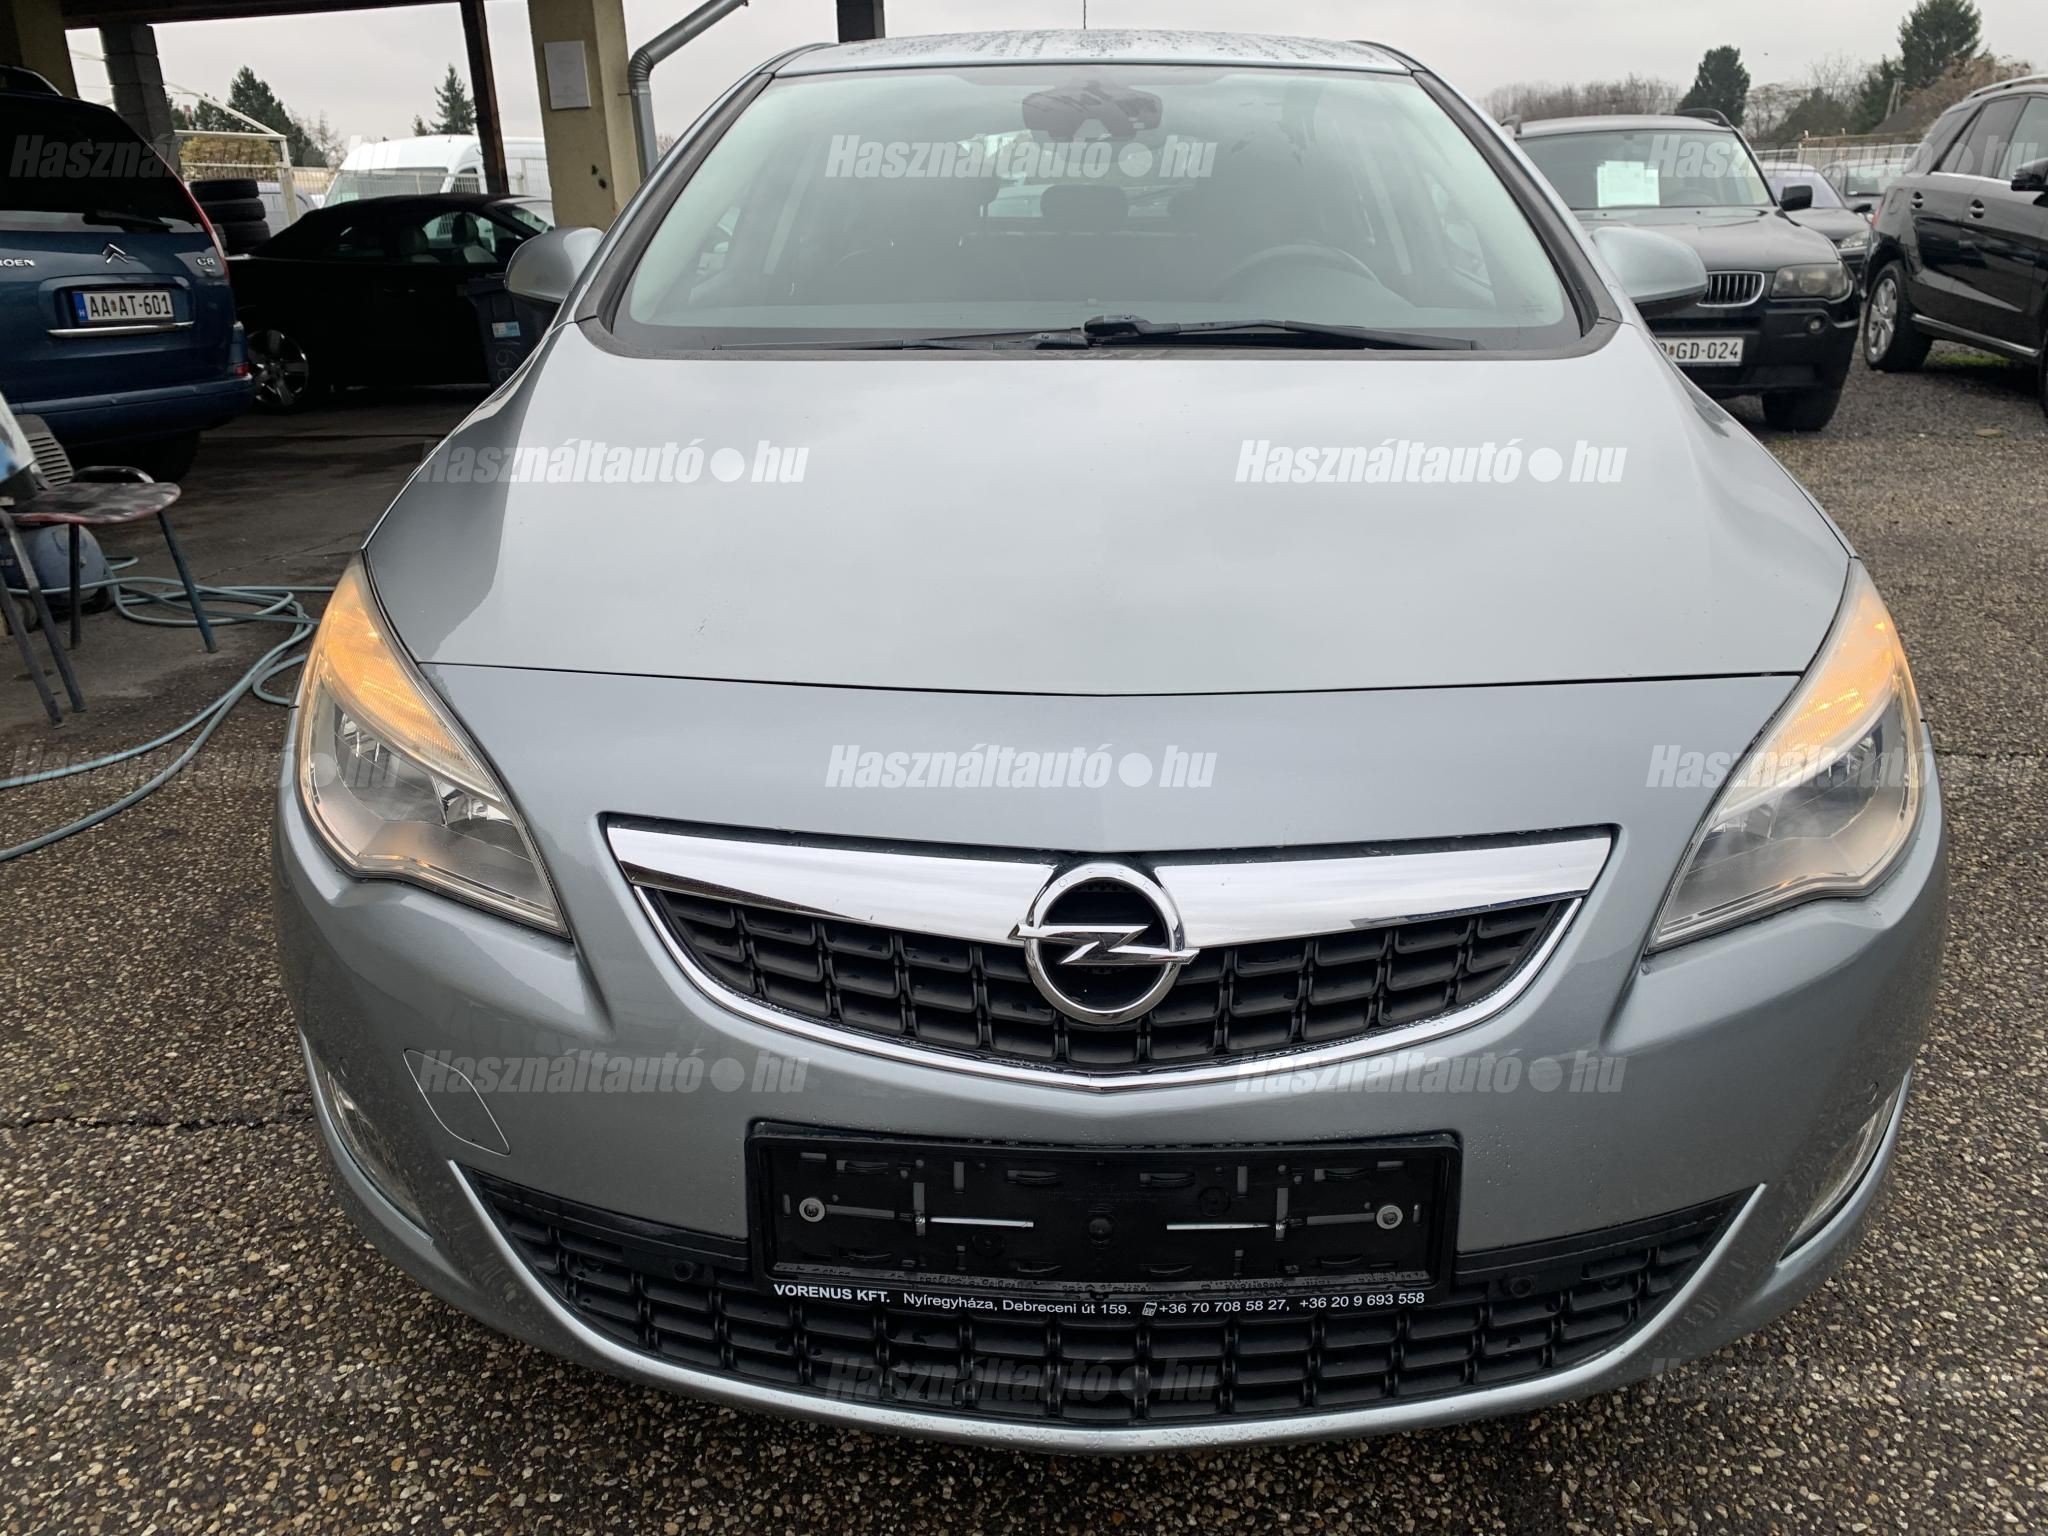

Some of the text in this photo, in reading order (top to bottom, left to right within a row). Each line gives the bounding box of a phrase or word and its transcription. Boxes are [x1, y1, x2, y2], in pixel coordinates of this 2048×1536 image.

[774, 1284, 852, 1300] VORENUS
[857, 1289, 890, 1303] KFT.
[903, 1293, 998, 1311] Nyíregyháza,
[1003, 1300, 1077, 1315] Debreceni
[1081, 1300, 1095, 1315] út
[1100, 1304, 1131, 1315] 159.
[1192, 1302, 1210, 1314] 70
[1214, 1301, 1241, 1313] 708
[1245, 1300, 1264, 1312] 58
[1268, 1299, 1290, 1312] 27,
[1300, 1298, 1327, 1309] +36
[1331, 1296, 1349, 1308] 20
[1353, 1296, 1363, 1307] 9
[1367, 1294, 1394, 1307] 693
[1398, 1292, 1425, 1305] 558
